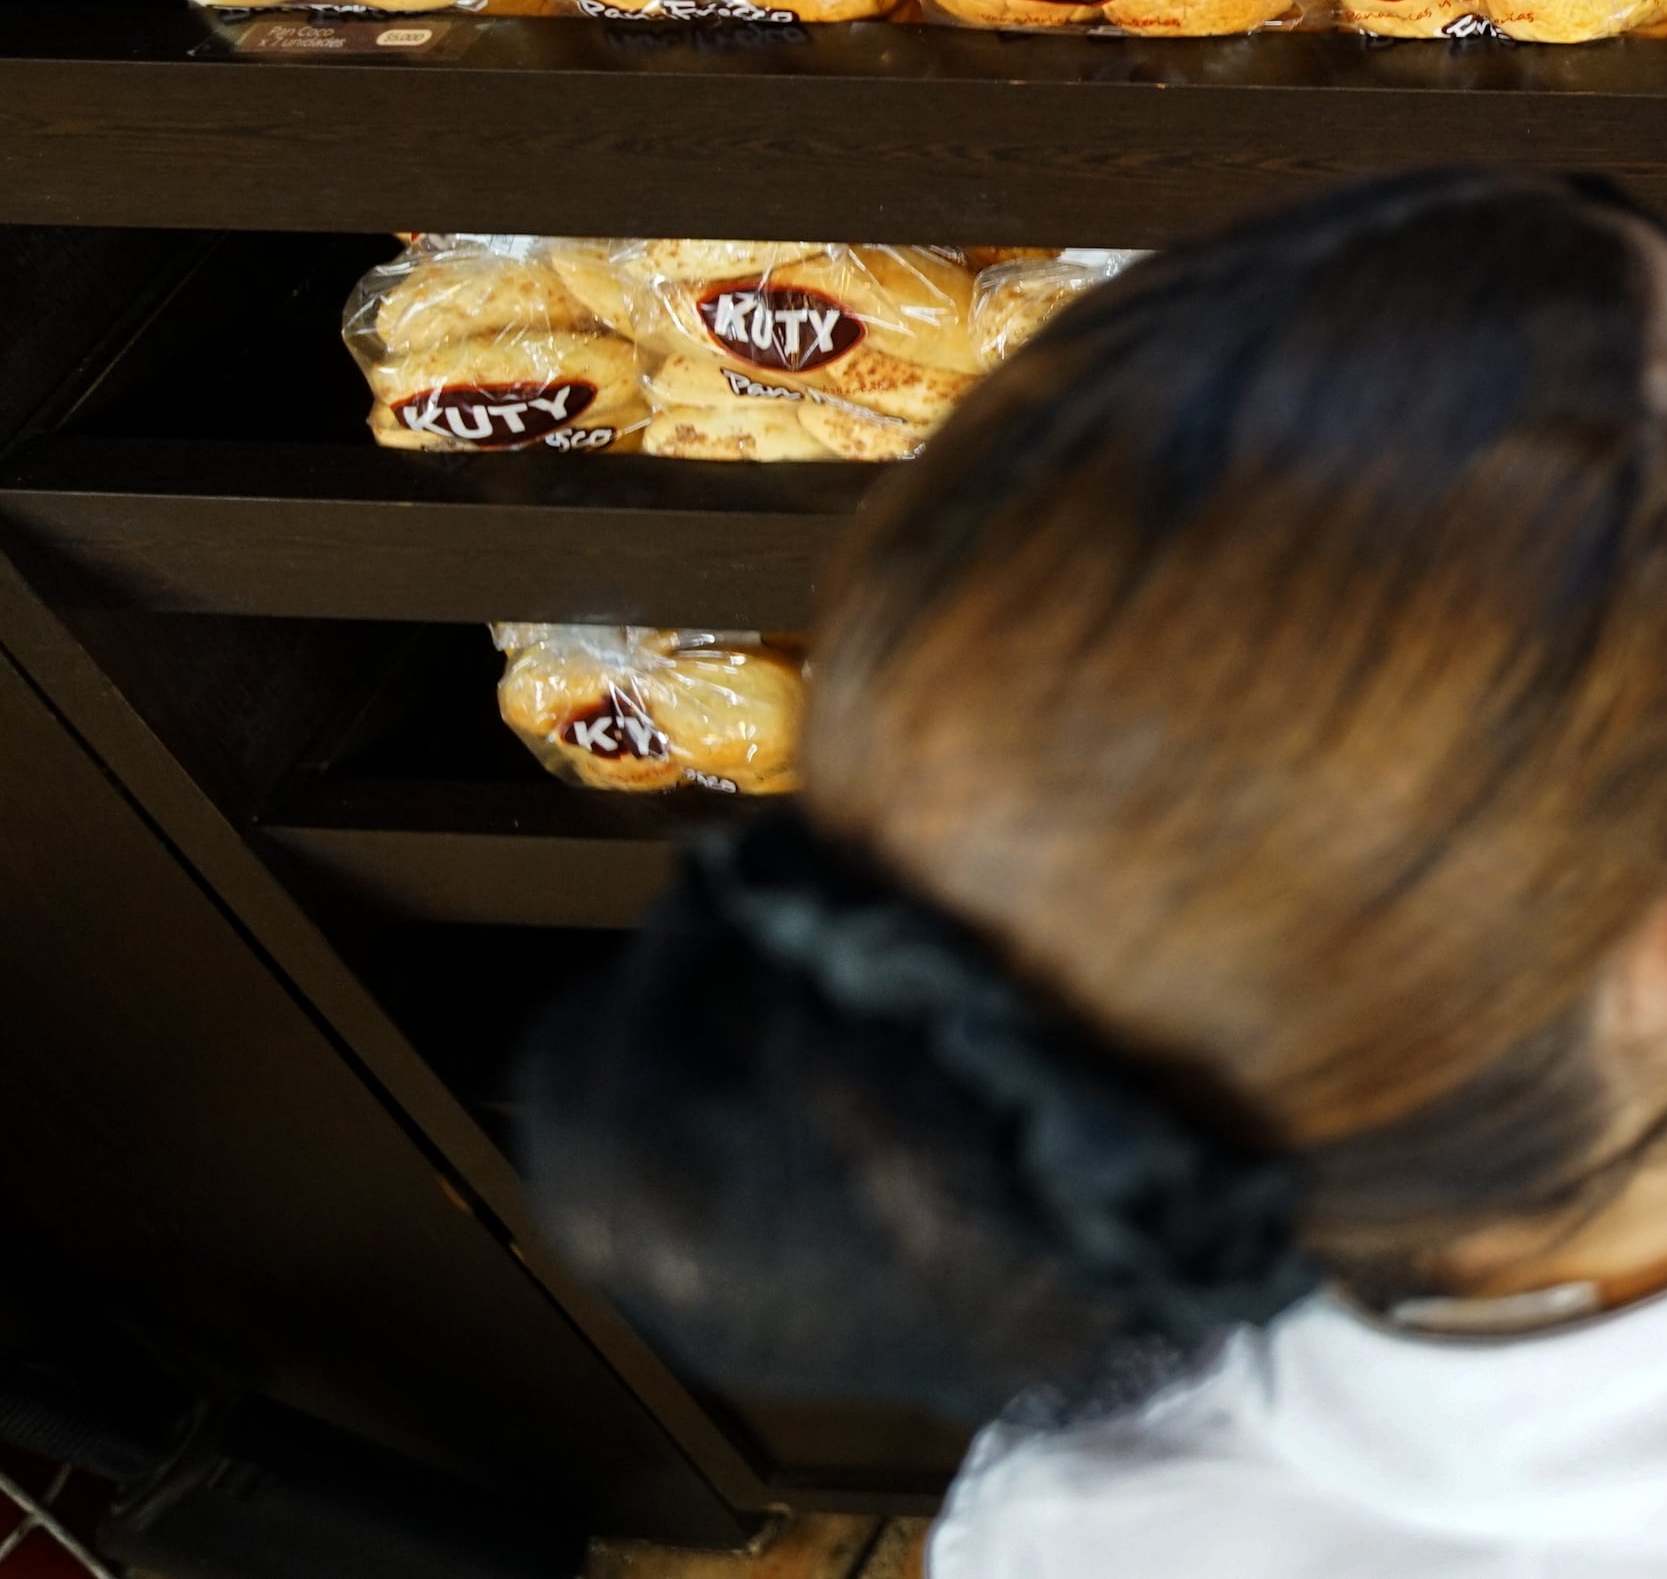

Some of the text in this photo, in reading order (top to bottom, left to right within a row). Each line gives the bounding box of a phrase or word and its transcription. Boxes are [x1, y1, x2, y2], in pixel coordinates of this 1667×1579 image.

[268, 26, 335, 38] Pan Coco
[714, 293, 841, 354] KUTY
[721, 368, 806, 401] Pan
[403, 385, 571, 440] KUTY
[574, 716, 652, 756] KY
